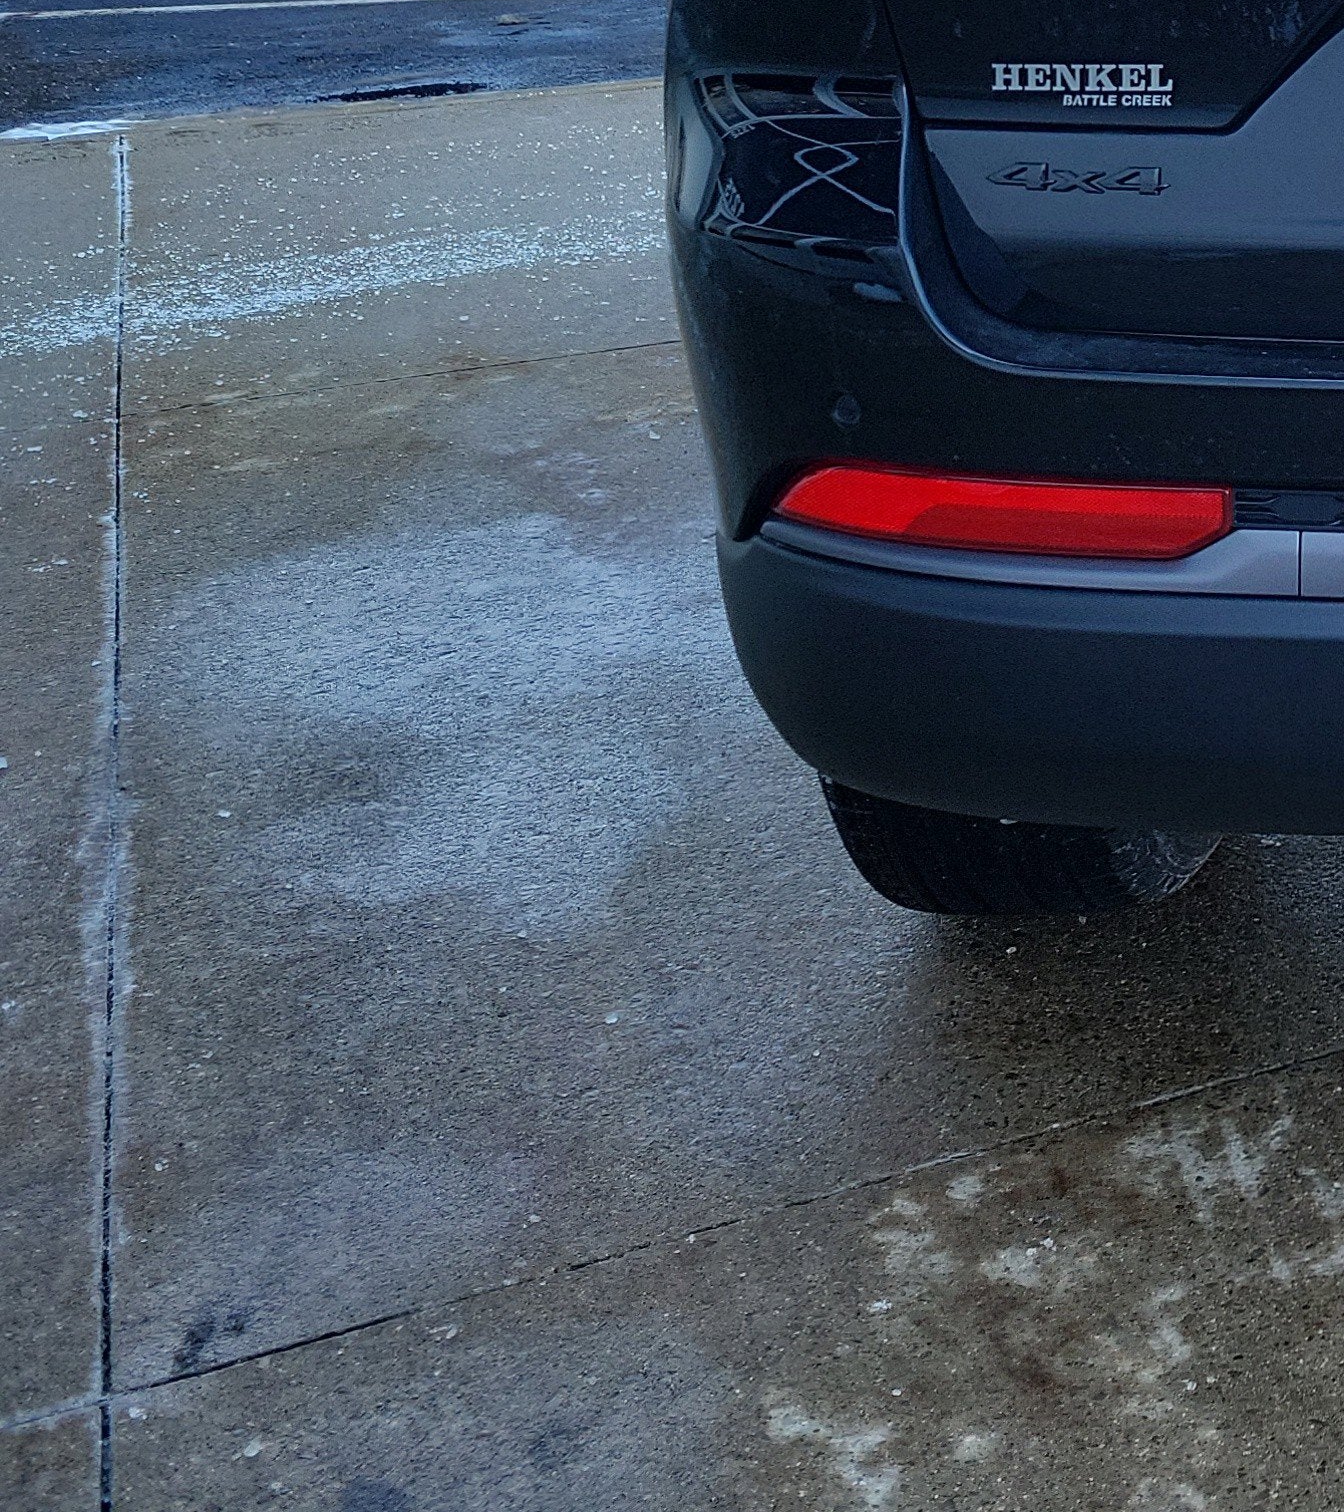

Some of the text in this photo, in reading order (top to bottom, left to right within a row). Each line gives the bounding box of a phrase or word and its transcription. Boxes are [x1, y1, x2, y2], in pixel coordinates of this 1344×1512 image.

[990, 62, 1174, 92] HENKEL
[1062, 94, 1173, 107] BATTLE CREEK
[985, 161, 1172, 196] 4x4
